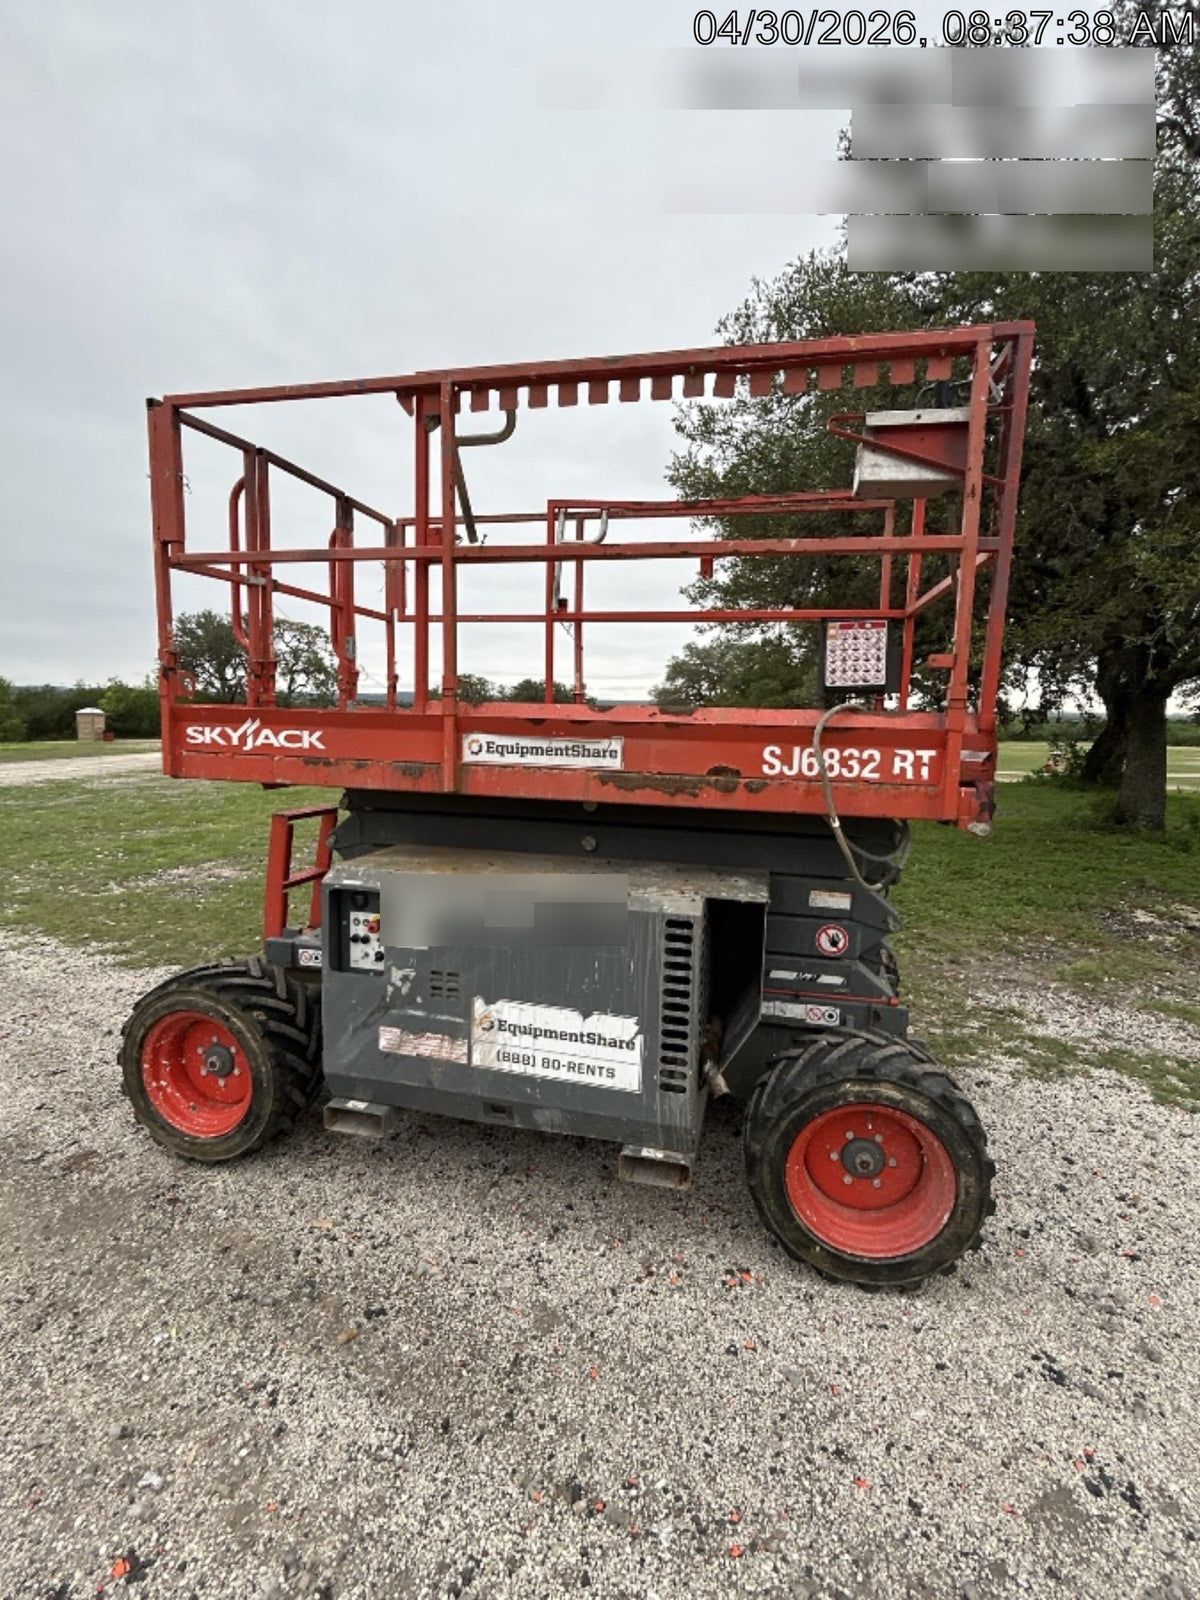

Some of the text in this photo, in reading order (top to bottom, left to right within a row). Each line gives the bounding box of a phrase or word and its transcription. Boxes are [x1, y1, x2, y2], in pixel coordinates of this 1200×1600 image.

[185, 717, 326, 751] SKYJACK
[485, 741, 618, 759] EquipmentShare
[762, 745, 936, 780] SJ6832 RT
[497, 1020, 636, 1051] EquipmentShare
[496, 1050, 616, 1079] (888) 80-RENTS
